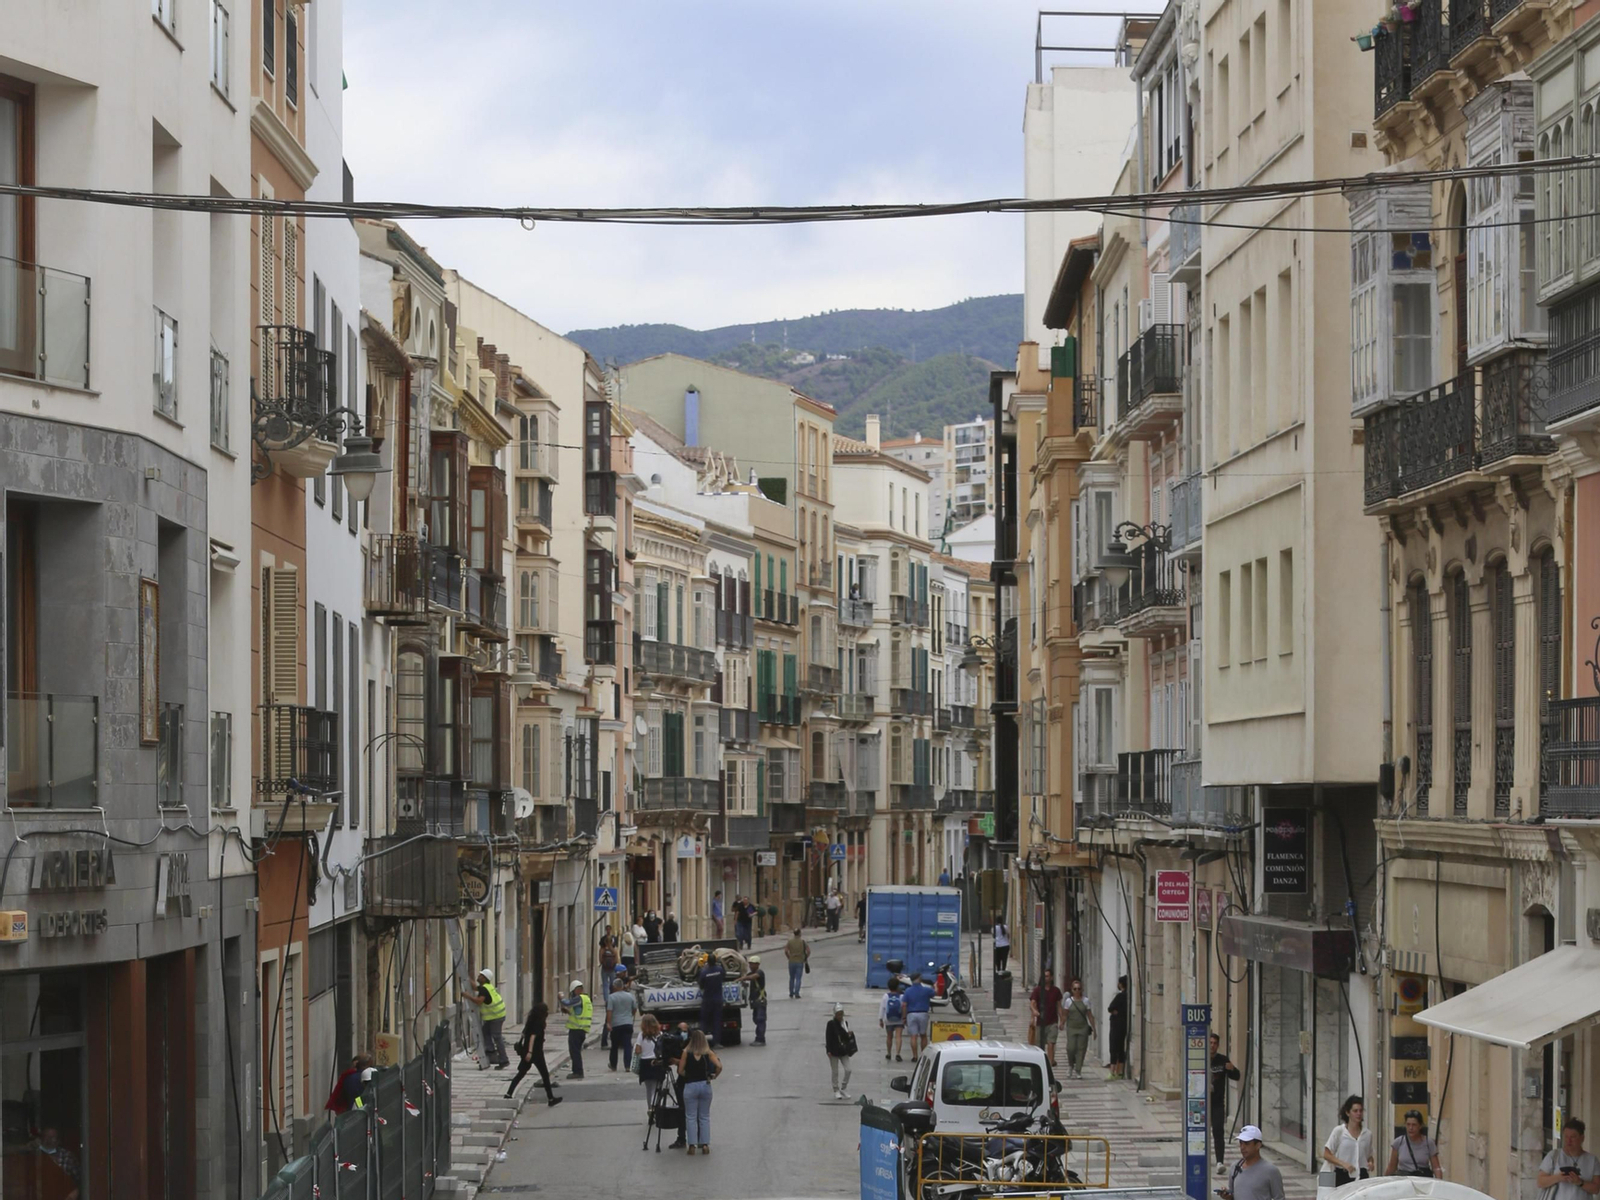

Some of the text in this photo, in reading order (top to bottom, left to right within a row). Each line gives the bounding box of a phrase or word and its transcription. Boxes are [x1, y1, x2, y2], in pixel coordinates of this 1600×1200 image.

[1267, 852, 1304, 860] FLAMENCA
[1265, 863, 1305, 872] COMUNIÓN
[1273, 877, 1298, 885] DANZA
[40, 907, 108, 938] DEPORTES
[1187, 1009, 1206, 1022] BUS
[1190, 1039, 1204, 1048] 36
